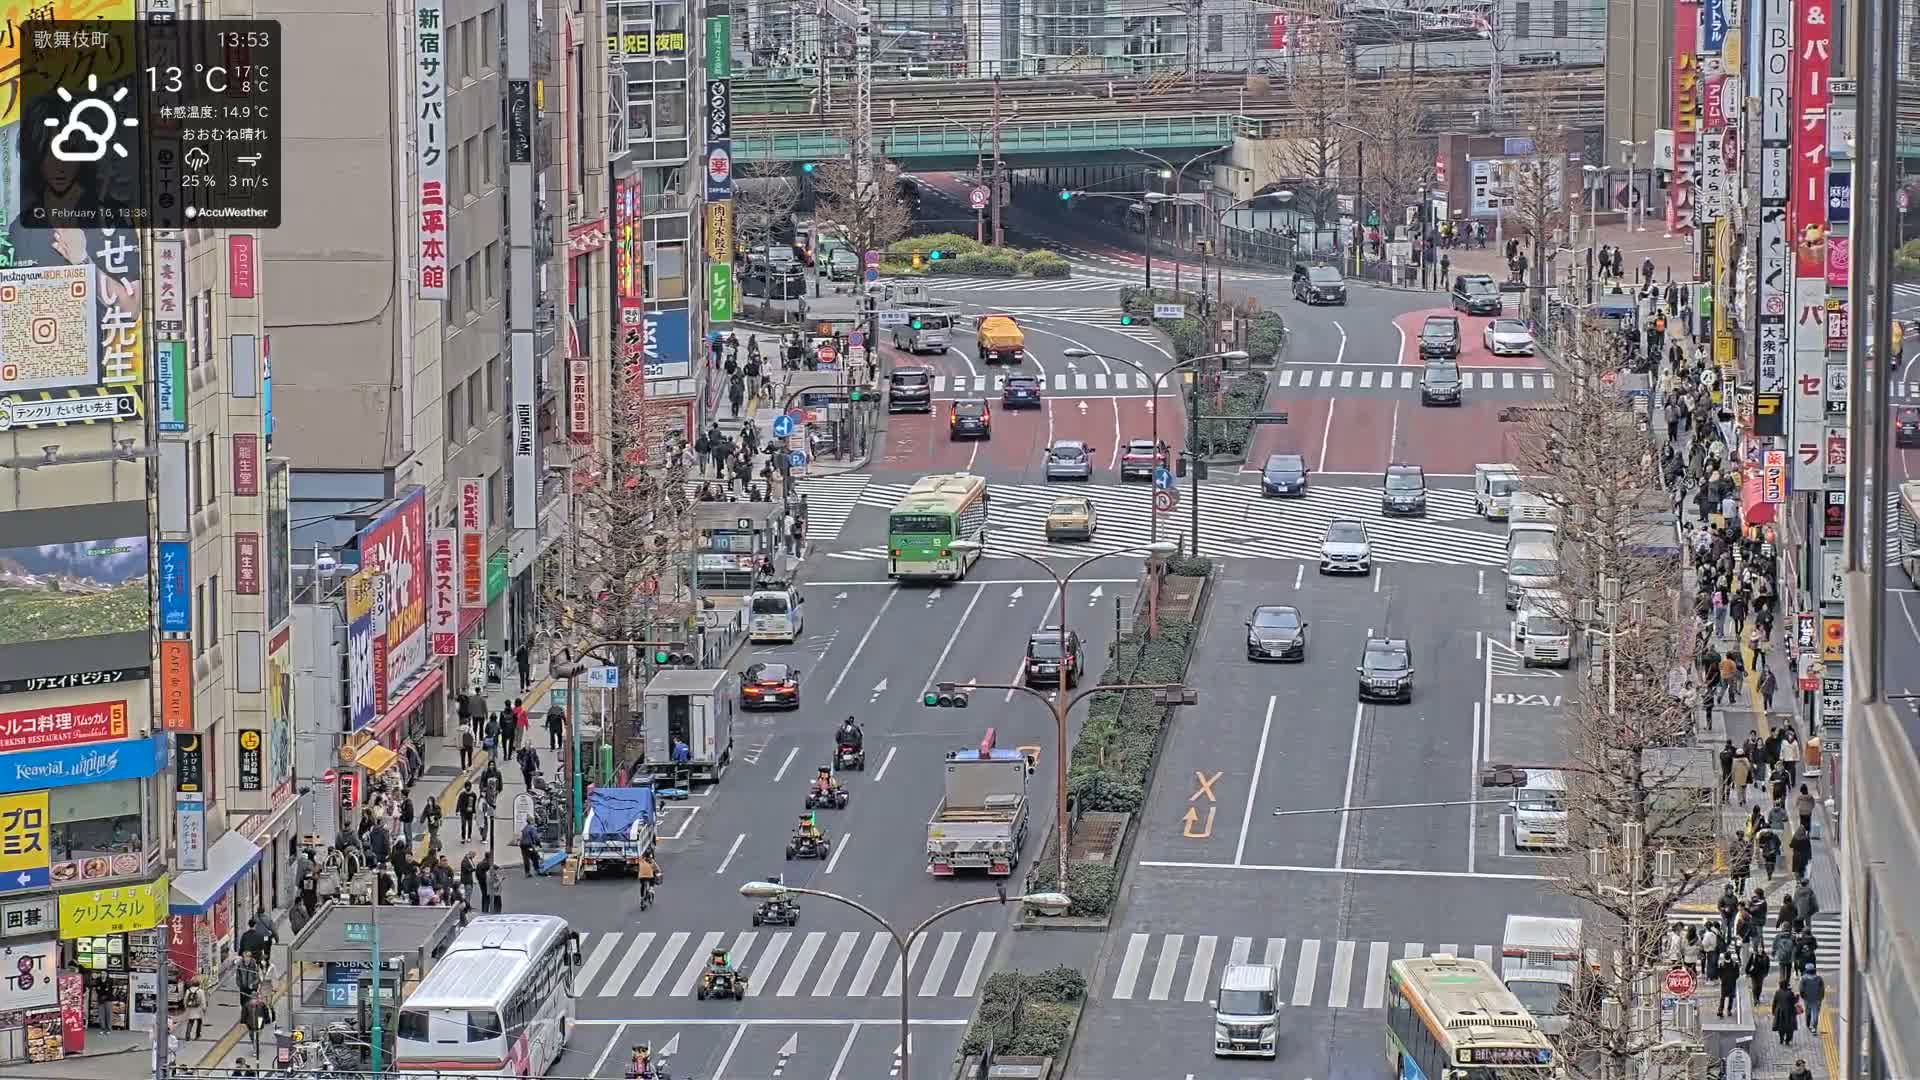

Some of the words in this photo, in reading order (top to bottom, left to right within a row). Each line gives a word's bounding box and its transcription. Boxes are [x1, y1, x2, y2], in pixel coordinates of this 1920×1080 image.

[1807, 6, 1825, 25] &
[624, 34, 649, 53] 祝日
[655, 32, 684, 52] 夜間
[418, 8, 442, 167] 新宿サンパーク
[1802, 38, 1830, 201] パーティー
[1772, 150, 1780, 197] ESOLA
[421, 181, 444, 289] 三平本館
[713, 205, 727, 260] 肉汁水餃子
[713, 272, 727, 311] レイク
[161, 322, 178, 330] 3F
[1762, 326, 1777, 379] 大衆酒場
[160, 351, 171, 411] FamilyMart
[1798, 304, 1825, 467] パセラ
[17, 407, 51, 418] テンクリ
[516, 404, 532, 457] HOMEGAME
[463, 484, 475, 528] GAME
[436, 539, 453, 626] 三平ストア
[2, 808, 43, 833] プロ
[3, 833, 43, 855] ミス
[7, 907, 42, 929] 囲碁
[73, 900, 145, 924] クリスタル
[331, 988, 345, 1001] 12
